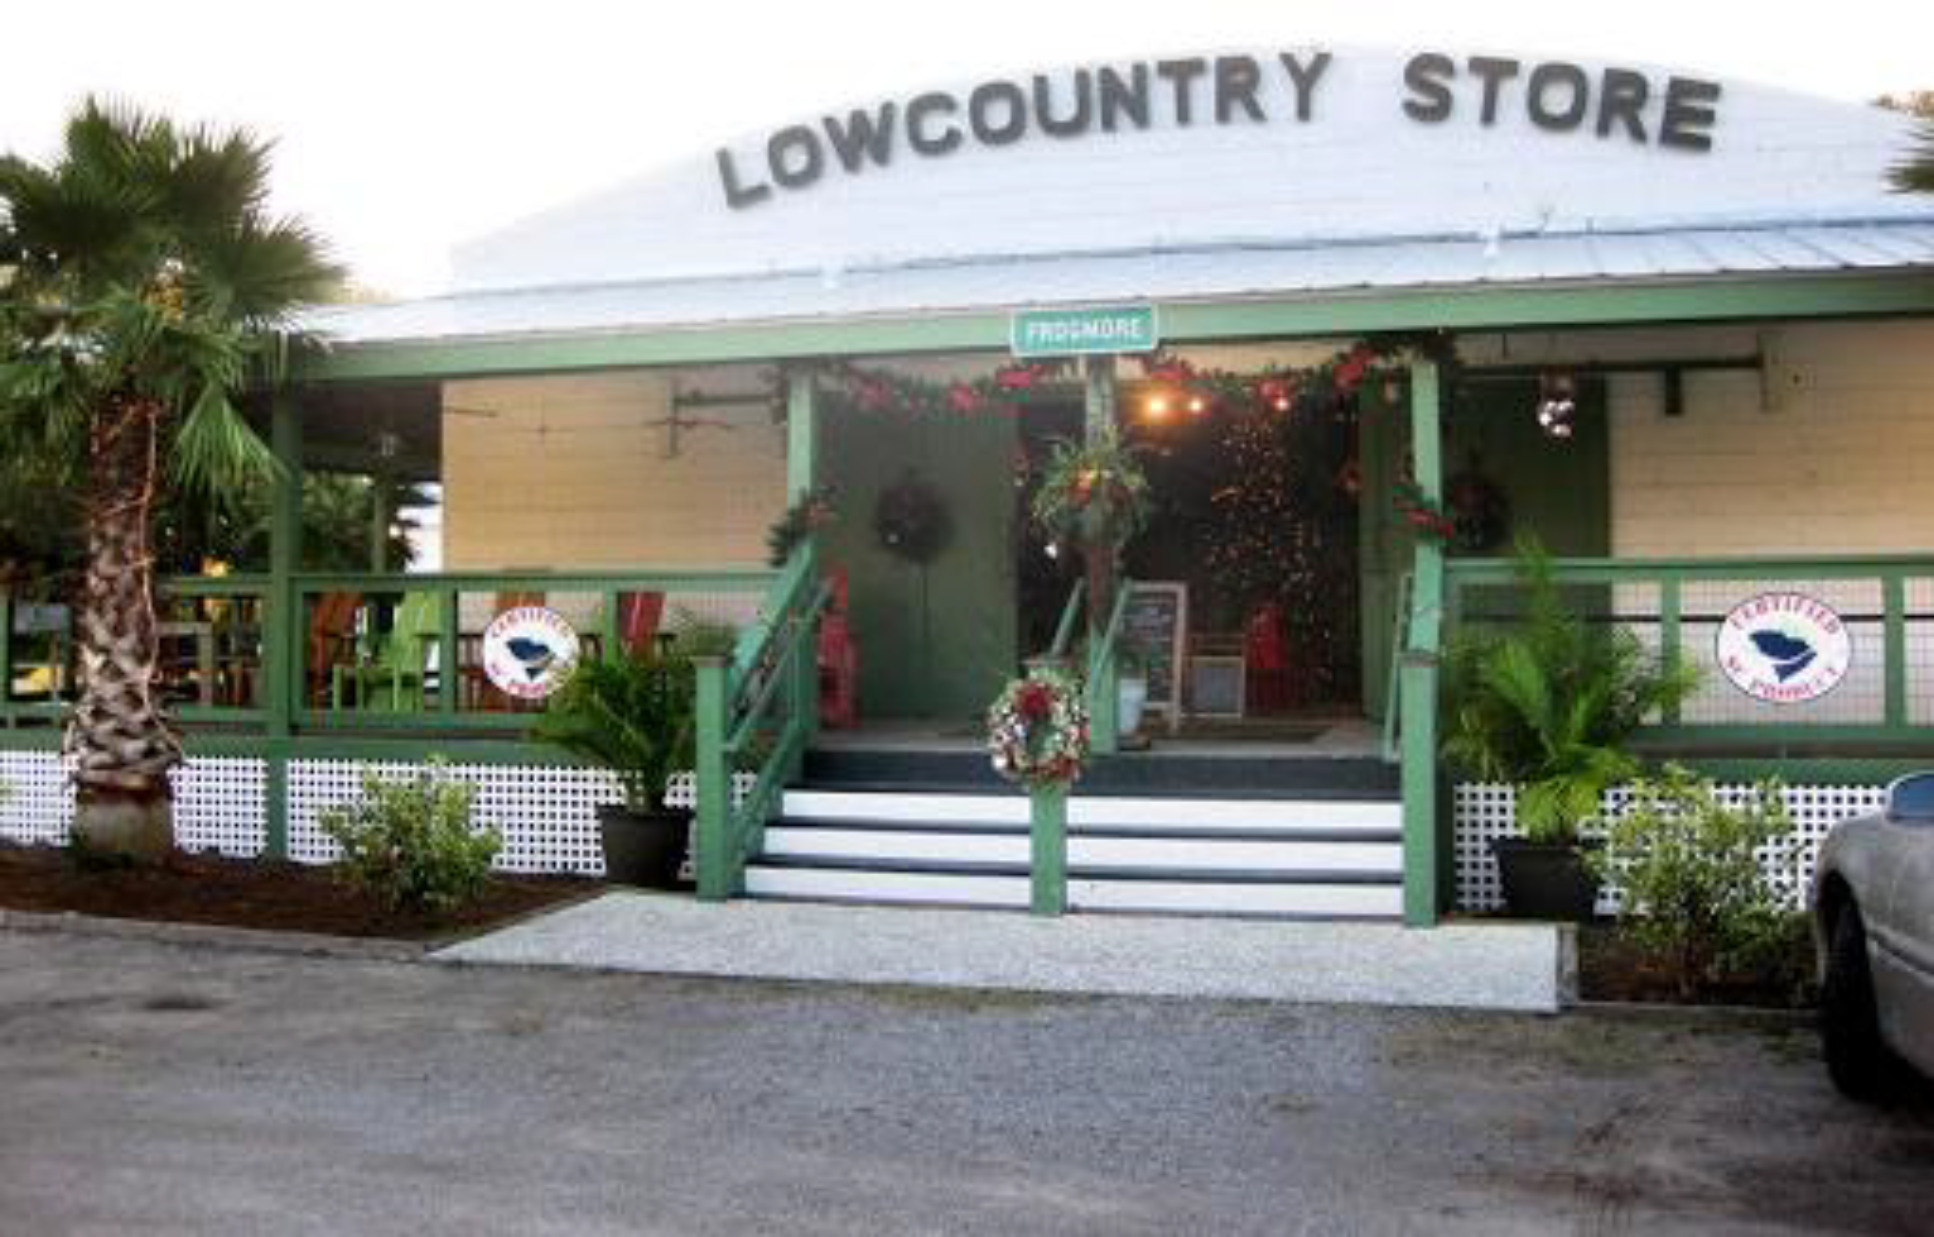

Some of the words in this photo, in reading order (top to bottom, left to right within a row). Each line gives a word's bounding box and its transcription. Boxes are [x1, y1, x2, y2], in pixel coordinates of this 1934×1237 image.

[715, 51, 1332, 210] LOWCOUNTRY
[1402, 52, 1722, 153] STORE
[1028, 317, 1143, 342] FROGMORE
[1729, 596, 1840, 635] CERTIFIED
